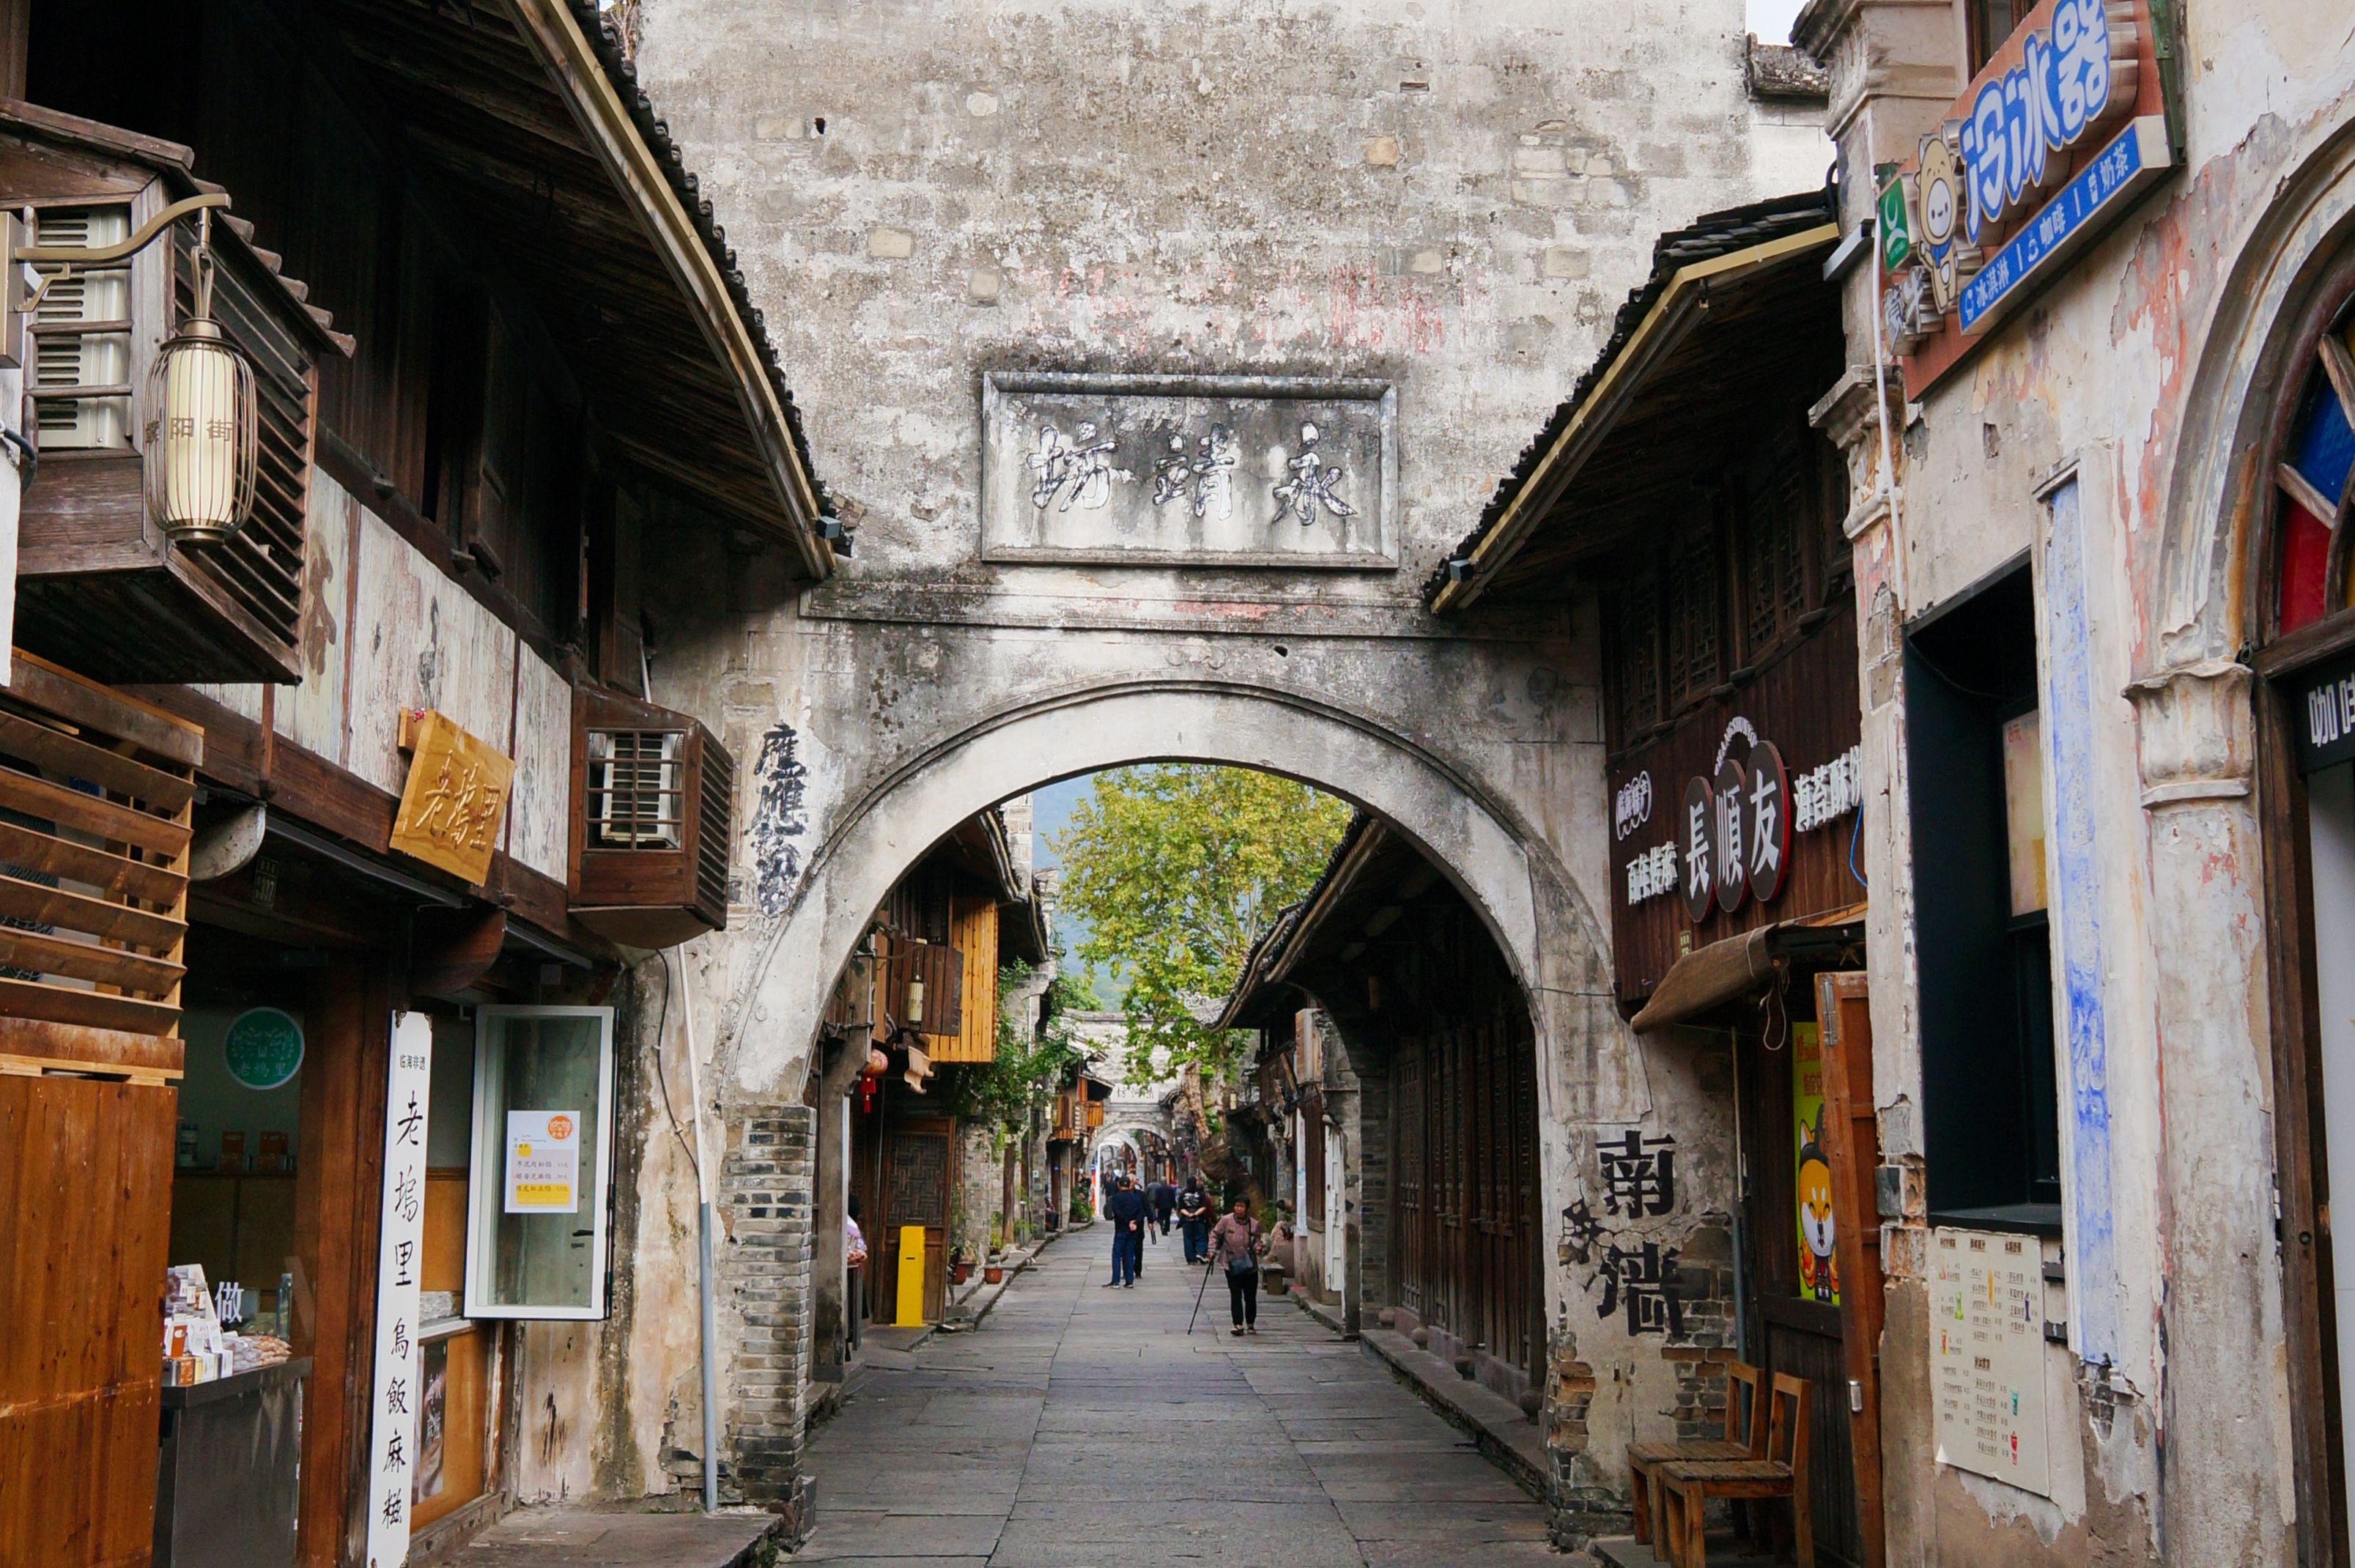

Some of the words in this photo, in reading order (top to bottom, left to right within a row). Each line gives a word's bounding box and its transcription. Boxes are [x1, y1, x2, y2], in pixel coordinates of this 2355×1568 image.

[1976, 256, 2010, 308] 冰淇淋
[2039, 203, 2066, 248] 咖啡
[2100, 142, 2129, 193] 奶茶
[146, 417, 234, 444] 紫阳街
[1685, 769, 1780, 899] 長順友
[215, 1281, 245, 1324] 做
